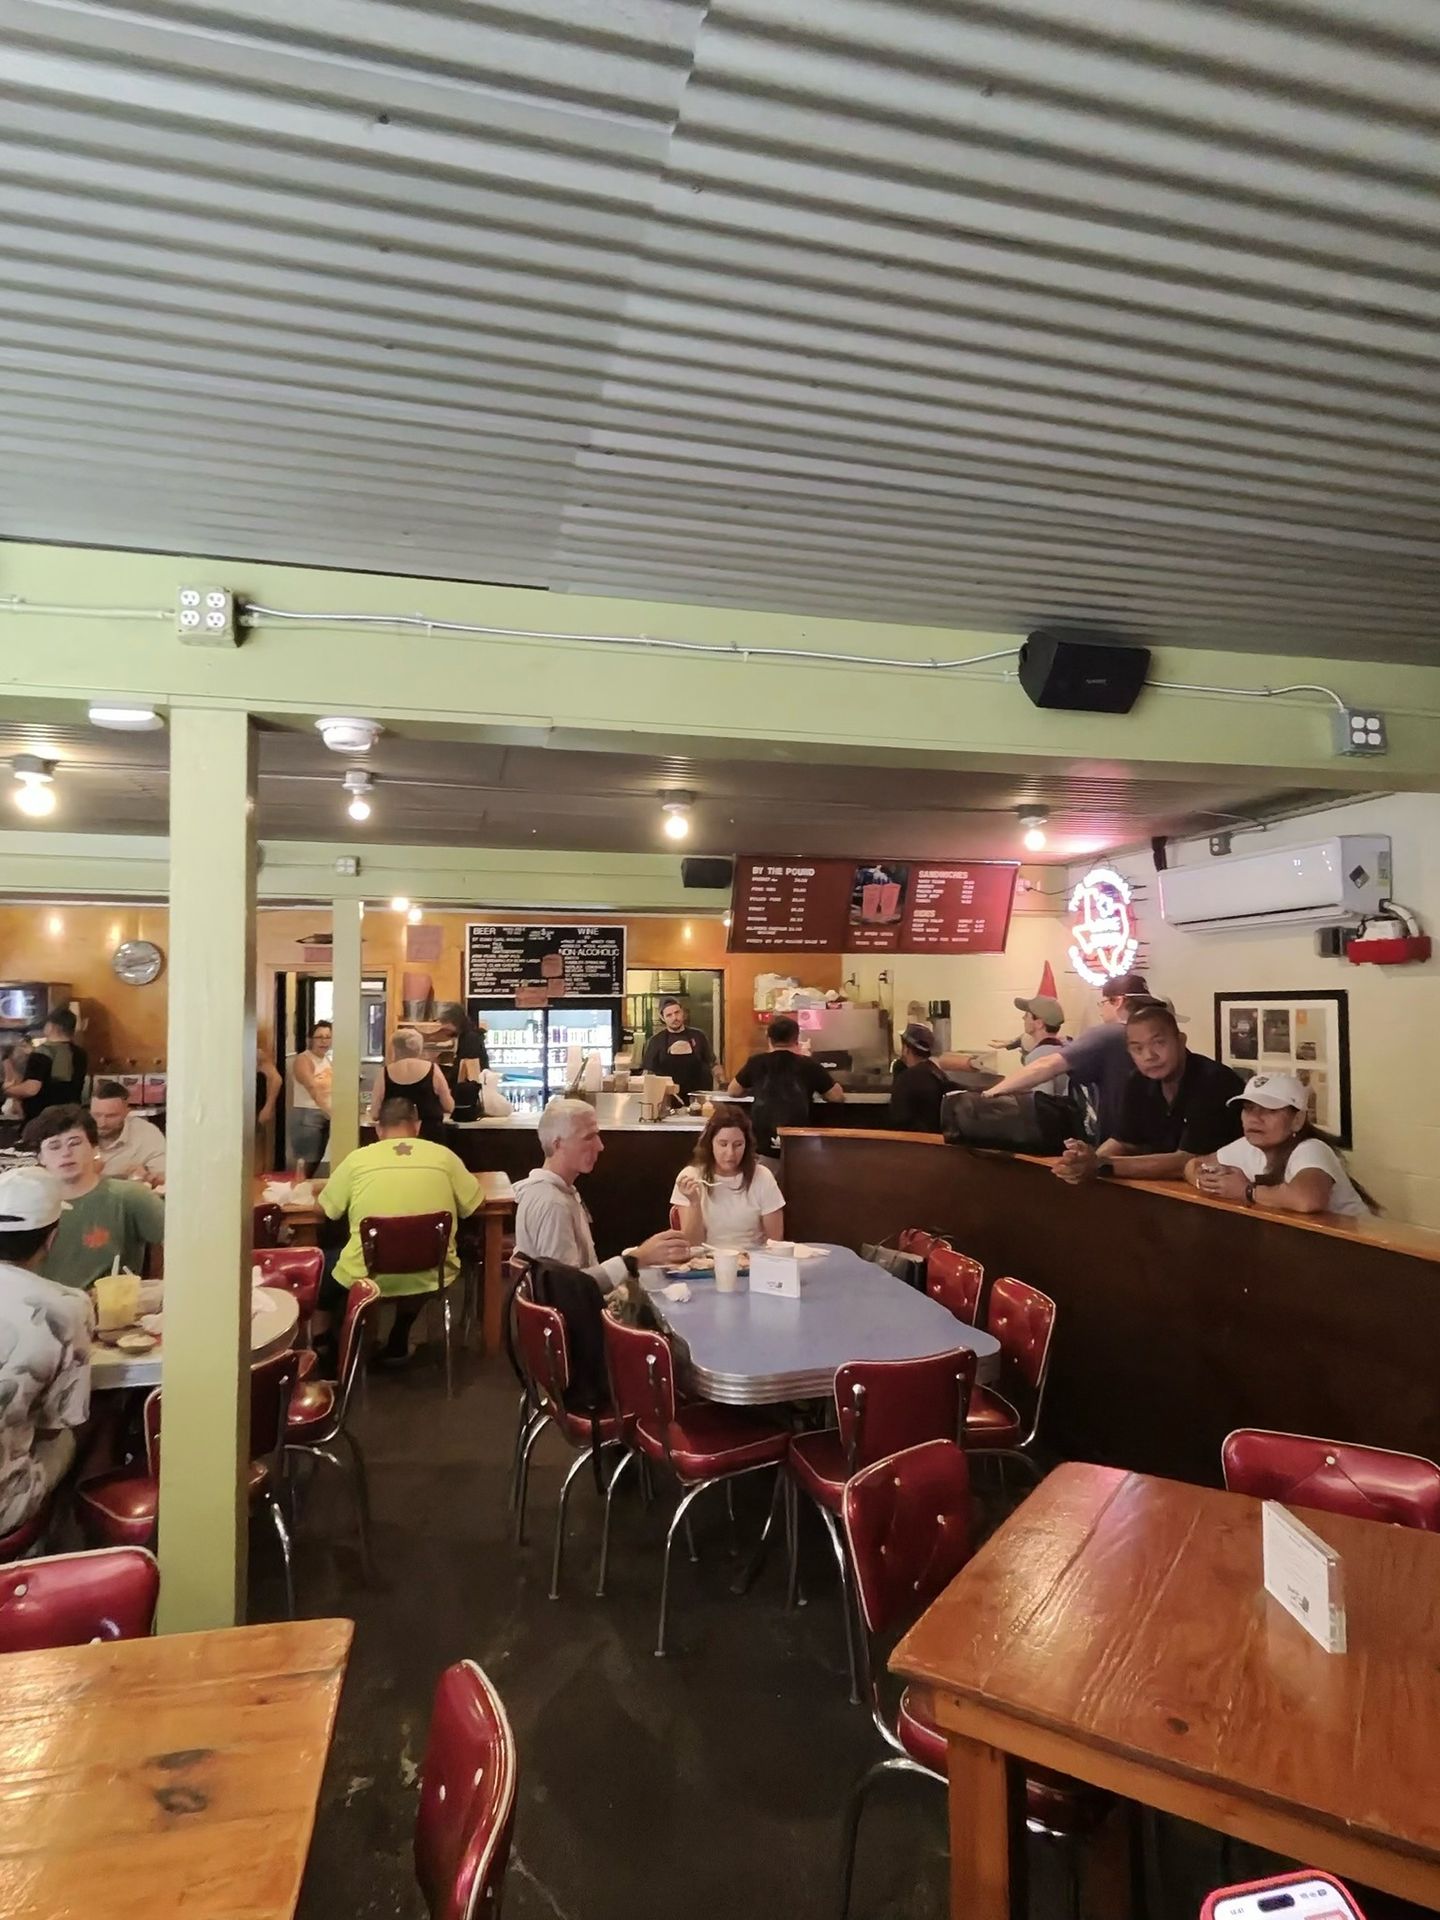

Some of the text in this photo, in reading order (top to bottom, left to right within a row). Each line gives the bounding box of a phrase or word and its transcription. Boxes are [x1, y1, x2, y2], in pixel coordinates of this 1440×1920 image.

[752, 866, 816, 876] BY THE POUND
[918, 870, 969, 879] SANDWICHES
[473, 927, 496, 935] BEER
[577, 928, 599, 936] WINE
[558, 948, 620, 957] NON ALCOHOLIC
